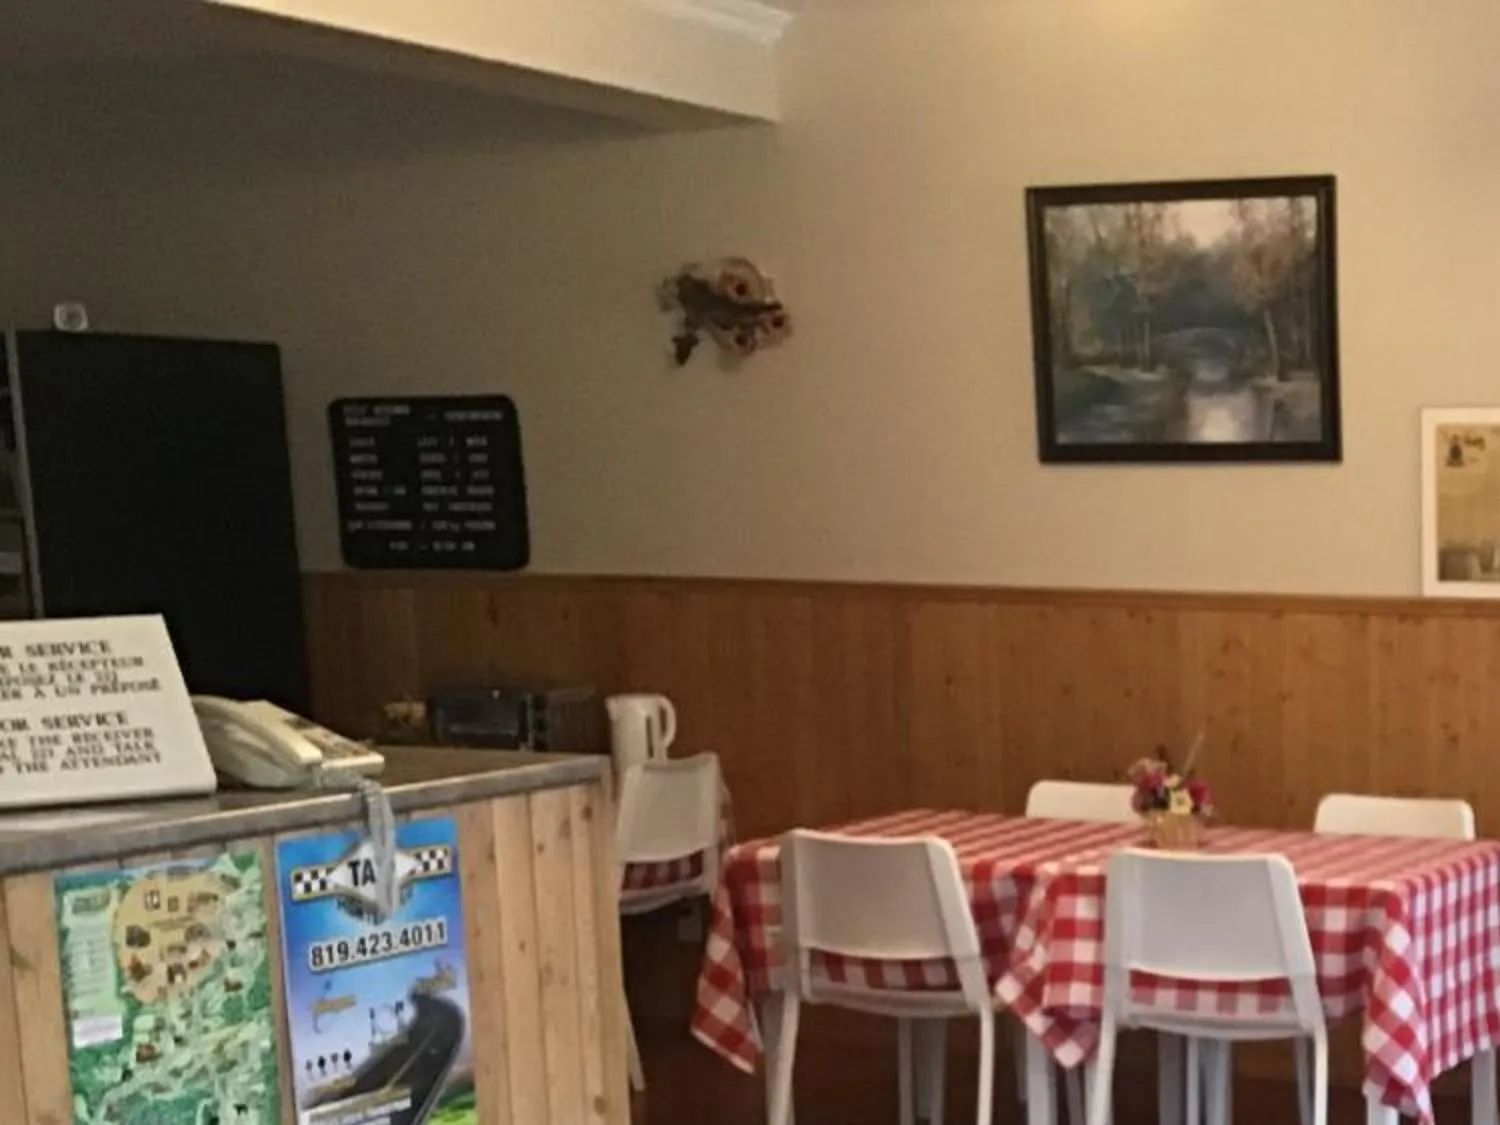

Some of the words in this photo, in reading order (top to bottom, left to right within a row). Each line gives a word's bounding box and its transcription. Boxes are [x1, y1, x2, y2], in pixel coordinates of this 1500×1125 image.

[25, 639, 111, 657] SERVICE
[41, 711, 127, 731] SERVICE
[348, 858, 378, 887] TA
